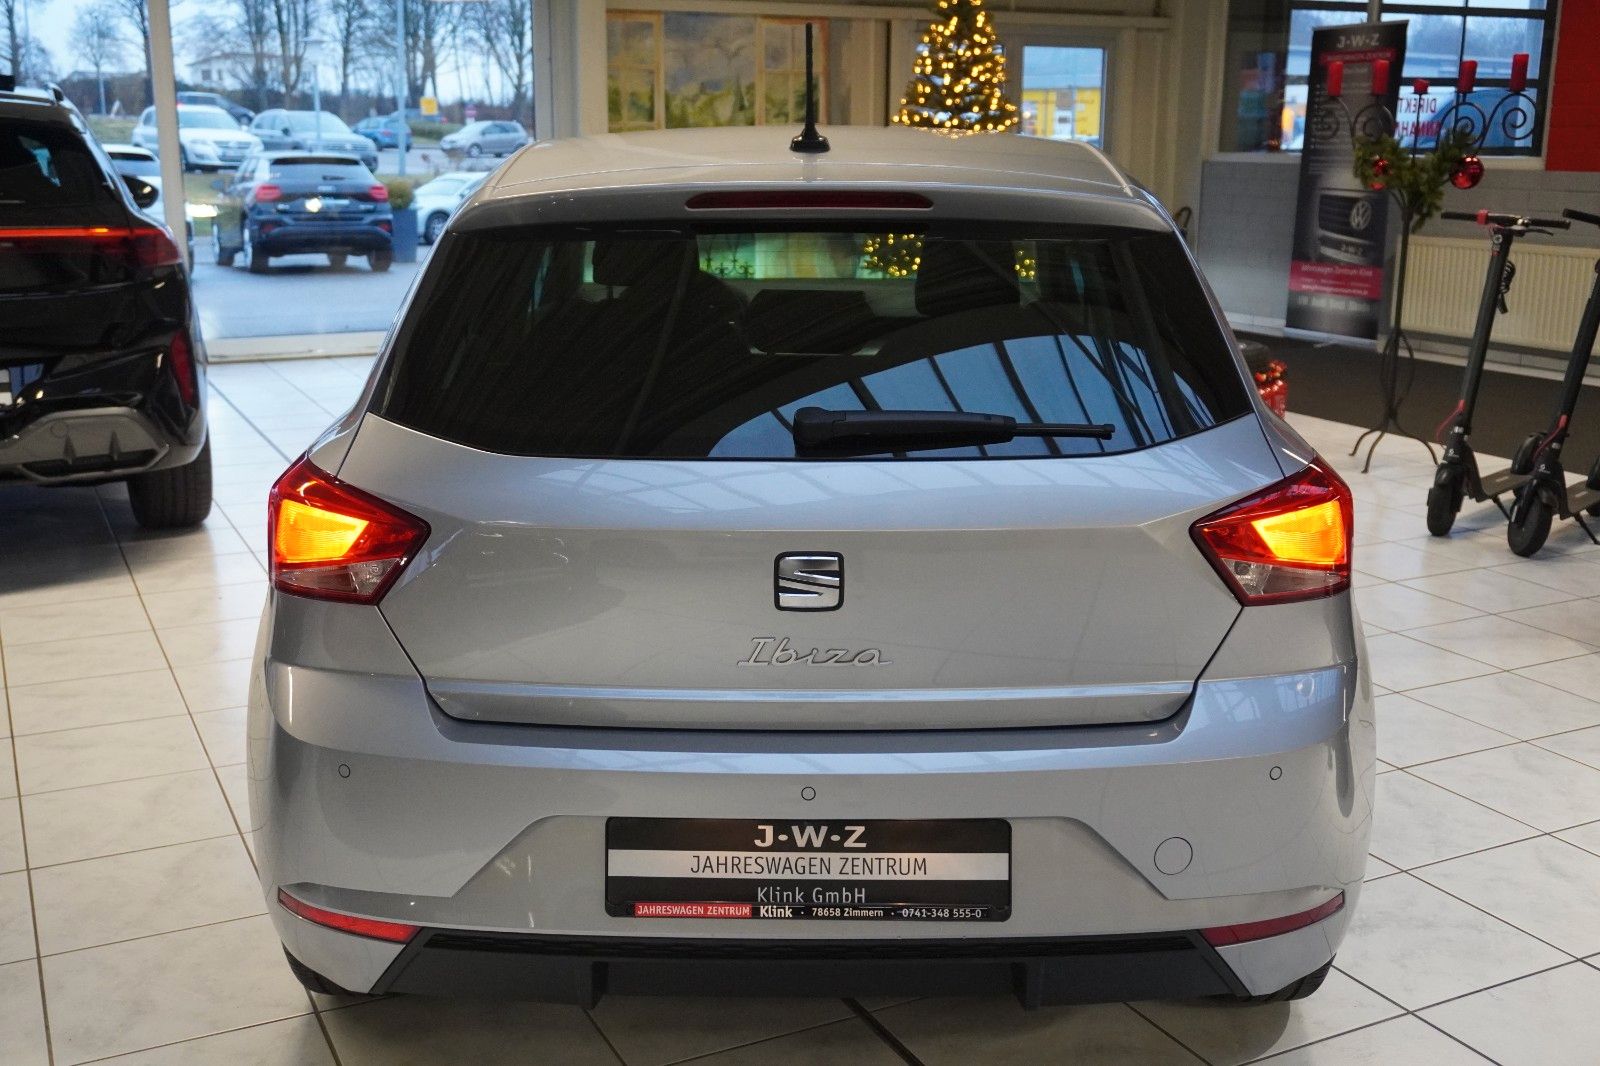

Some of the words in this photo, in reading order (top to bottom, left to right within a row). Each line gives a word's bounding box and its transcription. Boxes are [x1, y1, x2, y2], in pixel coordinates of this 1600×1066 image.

[737, 637, 893, 667] Ibiza
[690, 855, 831, 876] JAHRESWAGEN
[838, 857, 928, 876] ZENTRUM
[757, 886, 805, 903] Klink
[812, 887, 866, 904] GmbH
[637, 905, 704, 915] JAHRESWAGEN
[707, 906, 750, 916] ZENTRUM
[759, 905, 793, 918] Klink
[812, 907, 841, 917] 78658
[843, 907, 884, 917] Zimmern
[902, 908, 950, 918] 0741-348
[953, 909, 982, 918] 555-0
